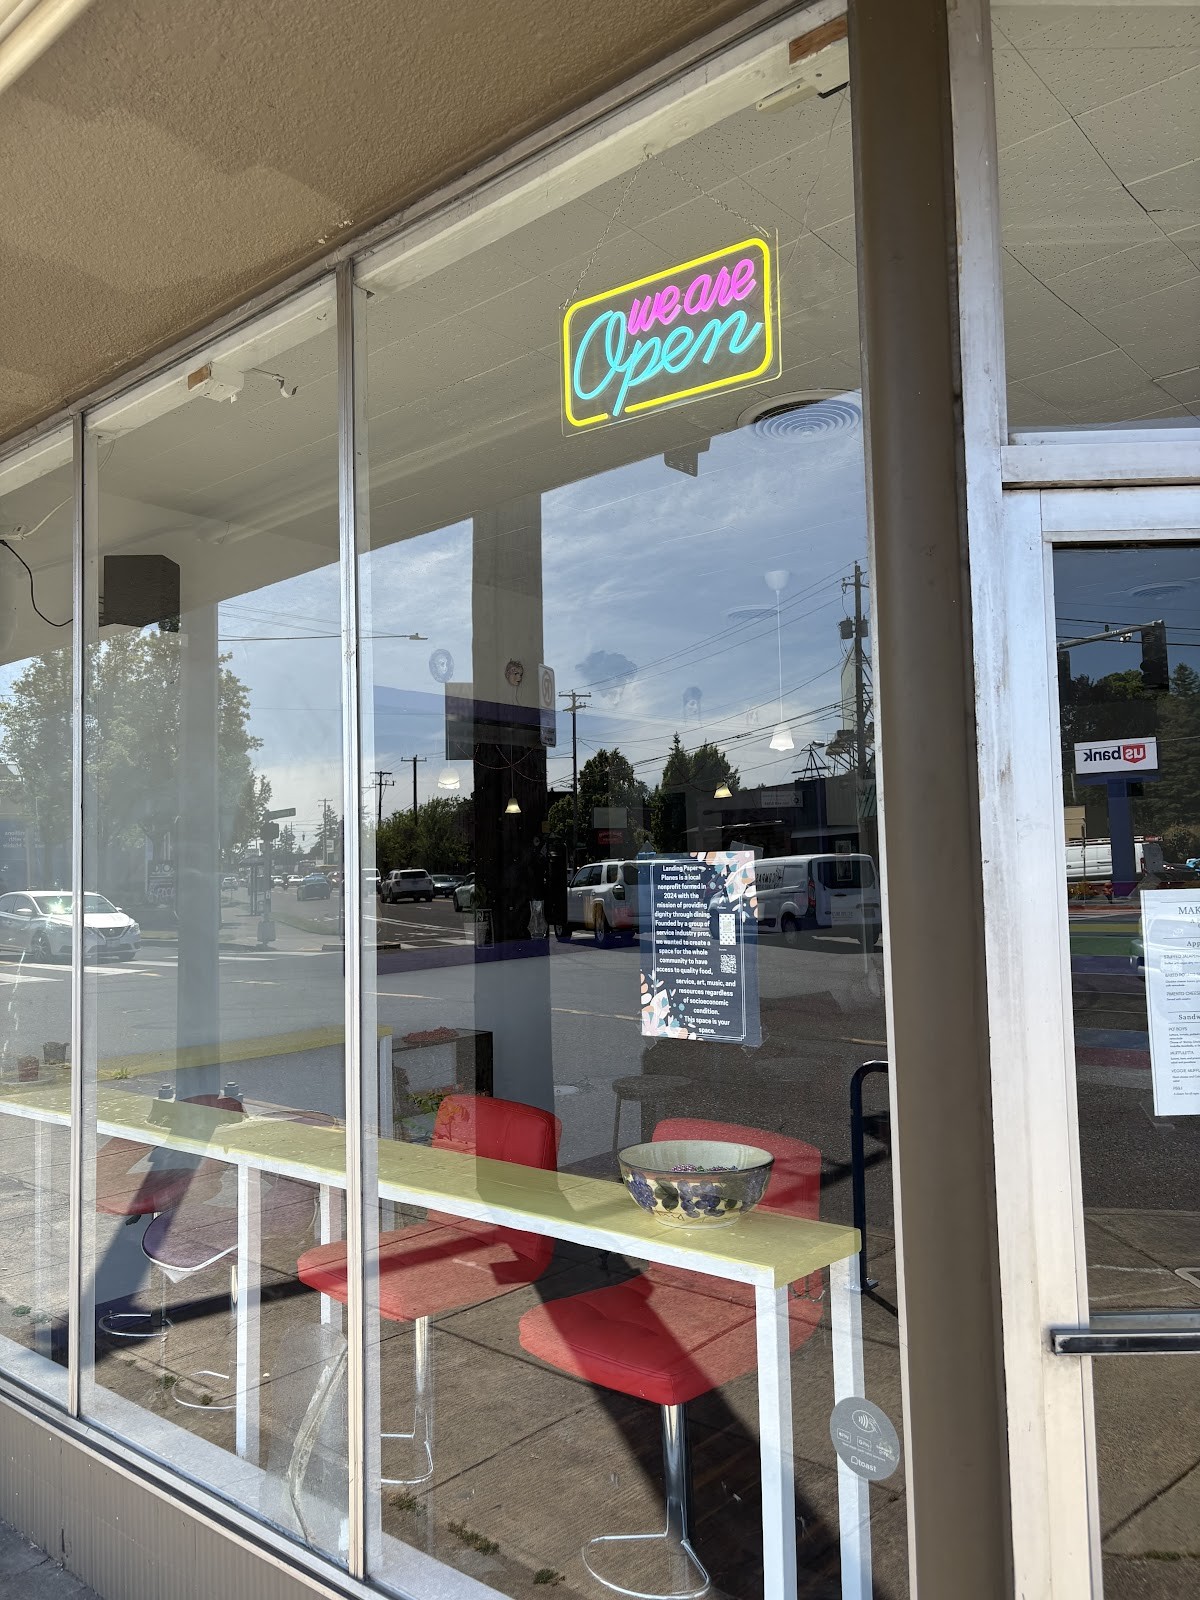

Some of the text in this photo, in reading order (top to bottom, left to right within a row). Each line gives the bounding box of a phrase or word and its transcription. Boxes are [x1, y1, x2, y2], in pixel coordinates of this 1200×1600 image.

[628, 258, 757, 336] we are
[573, 310, 764, 417] Open
[690, 998, 729, 1006] socioeconomic
[858, 1459, 877, 1472] toast
